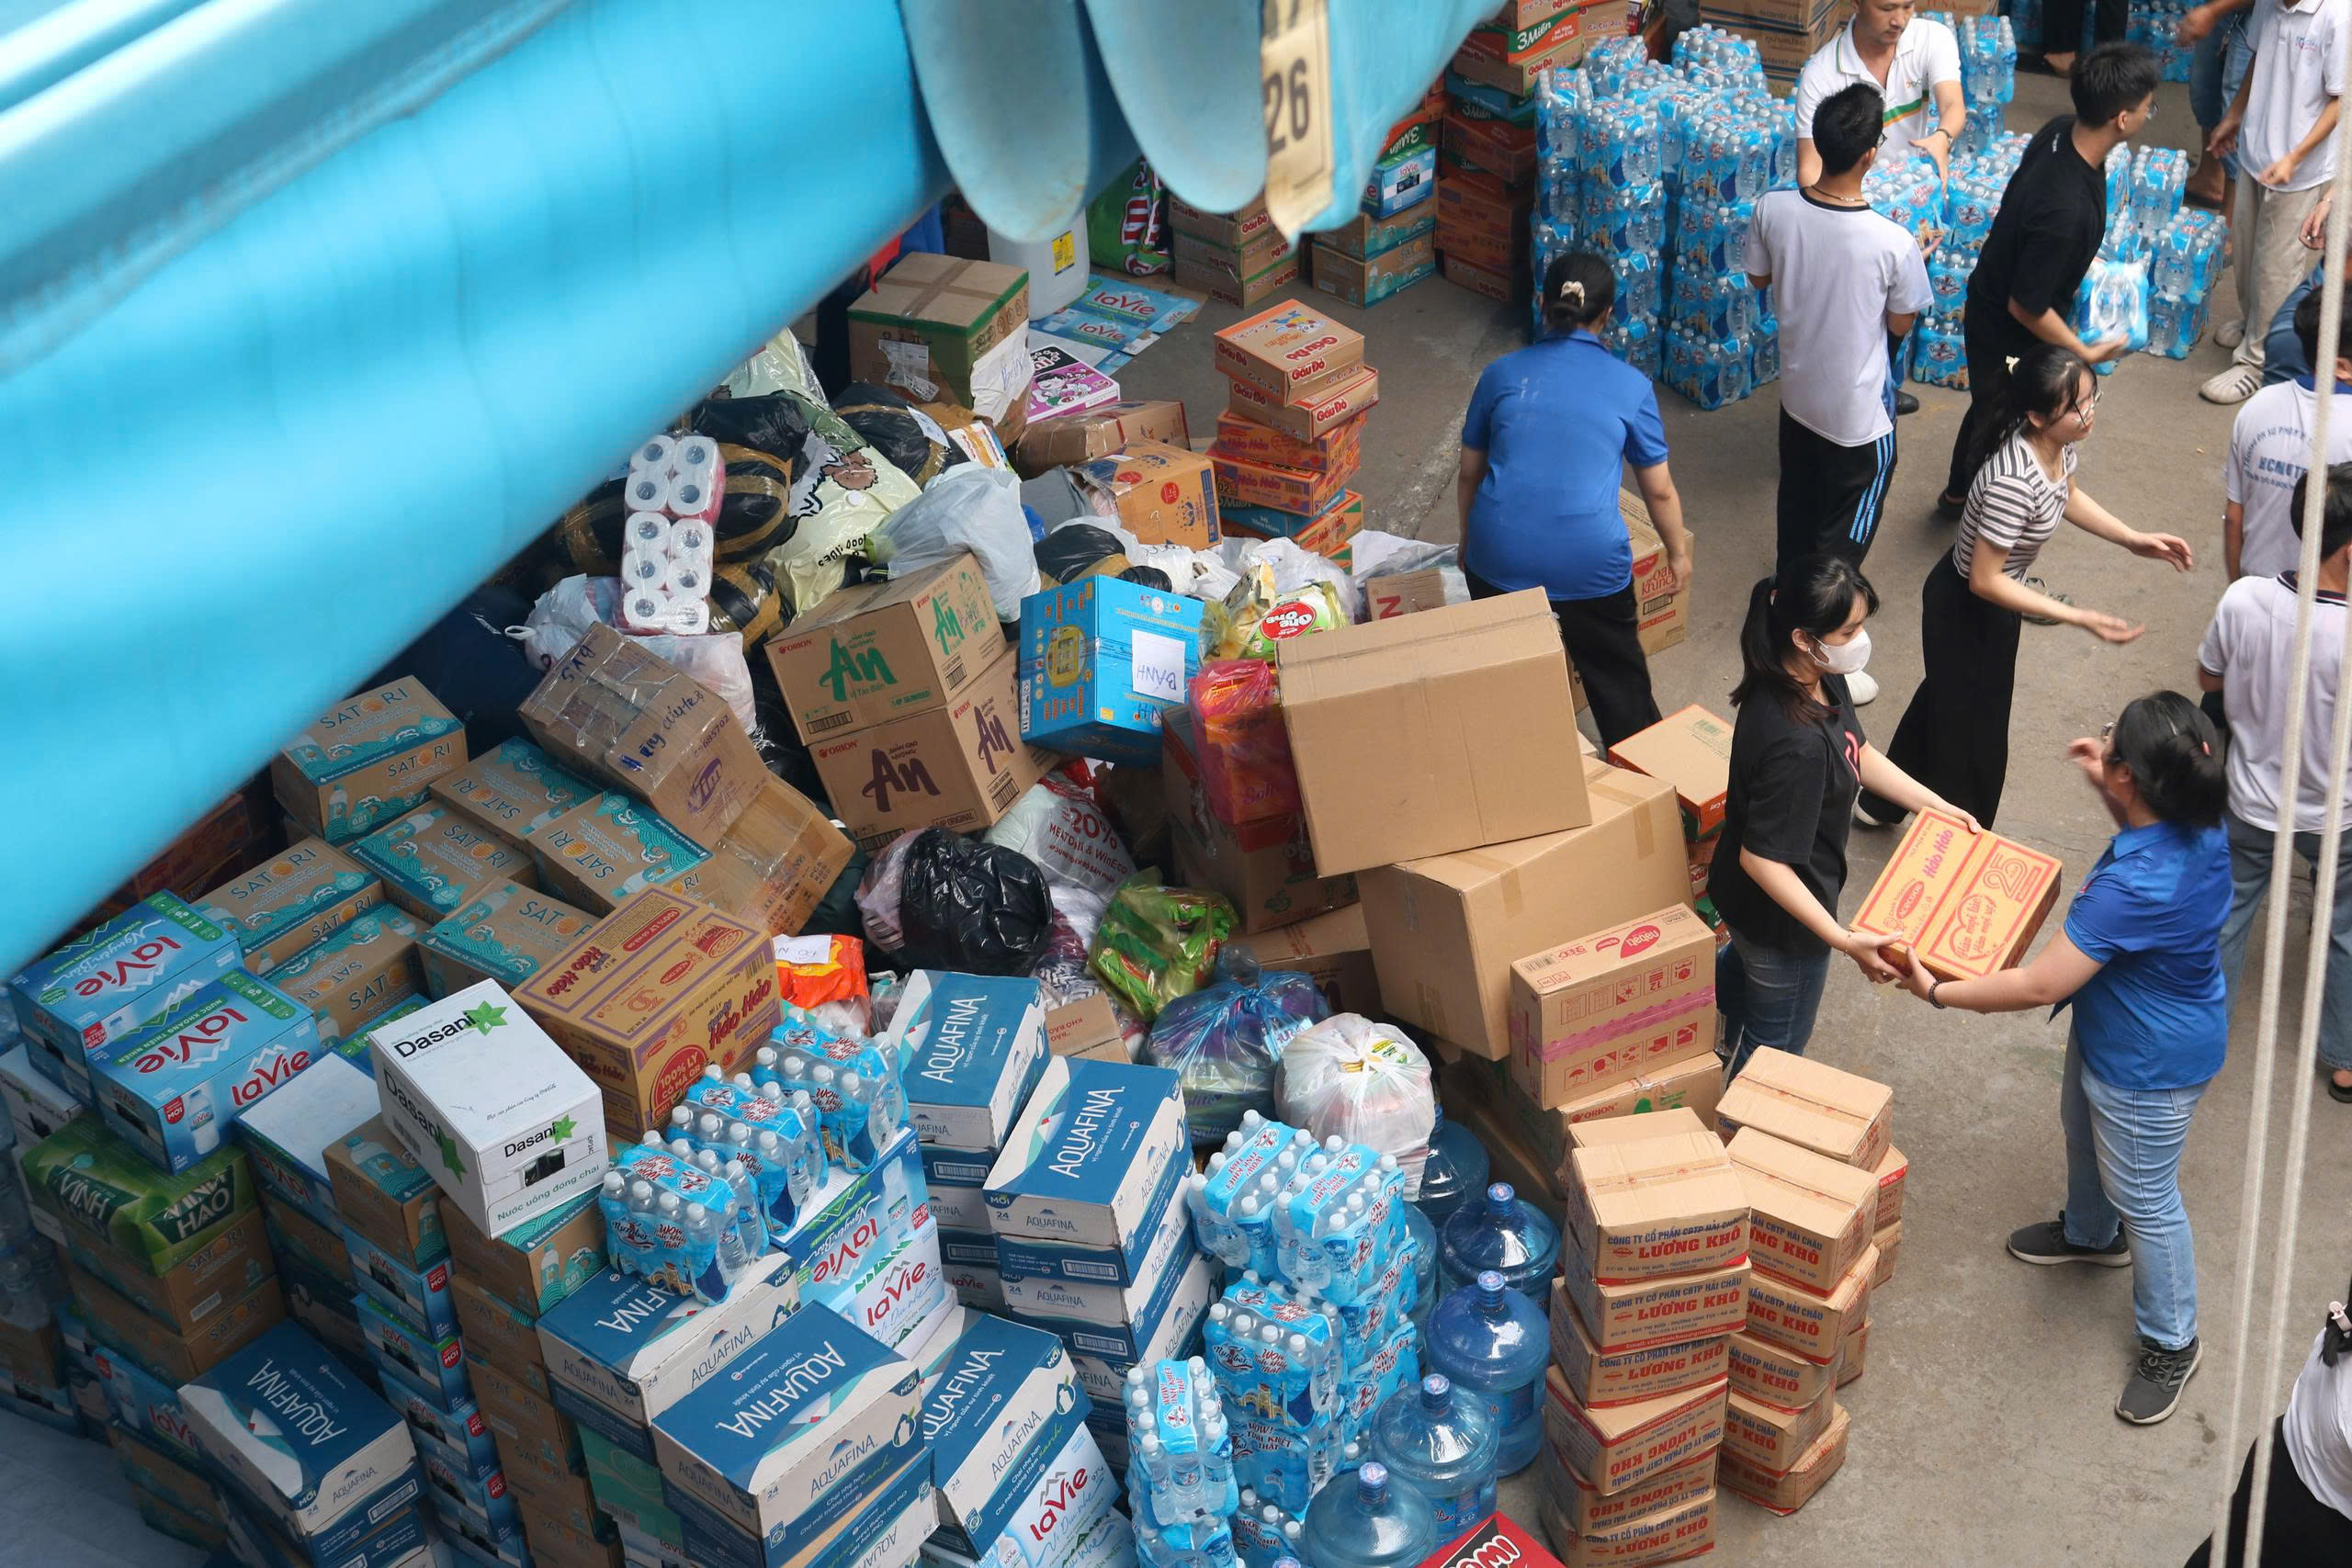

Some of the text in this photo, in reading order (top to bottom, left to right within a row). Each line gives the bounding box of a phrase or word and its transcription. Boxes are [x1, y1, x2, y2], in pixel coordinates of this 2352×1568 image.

[1093, 291, 1157, 316] laVie
[1078, 321, 1125, 341] laVie
[829, 739, 858, 757] ORION
[74, 936, 181, 996] laVie
[394, 1011, 476, 1058] Dasani
[709, 1010, 741, 1050] Hảo
[742, 979, 772, 1017] Hảo
[135, 1008, 248, 1073] laVie
[921, 995, 988, 1083] AQUAFINA
[232, 1051, 310, 1106] laVie
[661, 1051, 698, 1089] 100% LY
[383, 1068, 444, 1144] Dasani
[1583, 1103, 1615, 1119] ORION
[504, 1122, 557, 1157] Dasani
[1048, 1086, 1125, 1178] AQUAFINA
[497, 1165, 600, 1222] Nước uống đóng chai
[997, 1211, 1009, 1219] 24
[1026, 1215, 1076, 1232] AQUAFINA
[1638, 1225, 1741, 1258] LƯƠNG KHÔ
[813, 1219, 878, 1283] laVie
[1782, 1241, 1819, 1265] KHÔ
[866, 1262, 926, 1326] laVie
[1037, 1291, 1085, 1307] AQUAFINA
[1611, 1299, 1632, 1310] CÔNG
[1634, 1297, 1644, 1305] TY
[1682, 1285, 1703, 1295] CBTP
[1705, 1280, 1719, 1291] HẢI
[1637, 1288, 1740, 1321] LƯƠNG KHÔ
[1782, 1314, 1819, 1336] KHÔ
[691, 1325, 753, 1389] AQUAFINA
[247, 1358, 347, 1445] AQUAFINA
[718, 1340, 846, 1438] AQUAFINA
[810, 1434, 877, 1499] AQUAFINA
[992, 1410, 1044, 1481] AQUAFINA
[333, 1467, 376, 1503] AQUAFINA
[767, 1485, 779, 1499] 24
[1030, 1468, 1089, 1540] laVie
